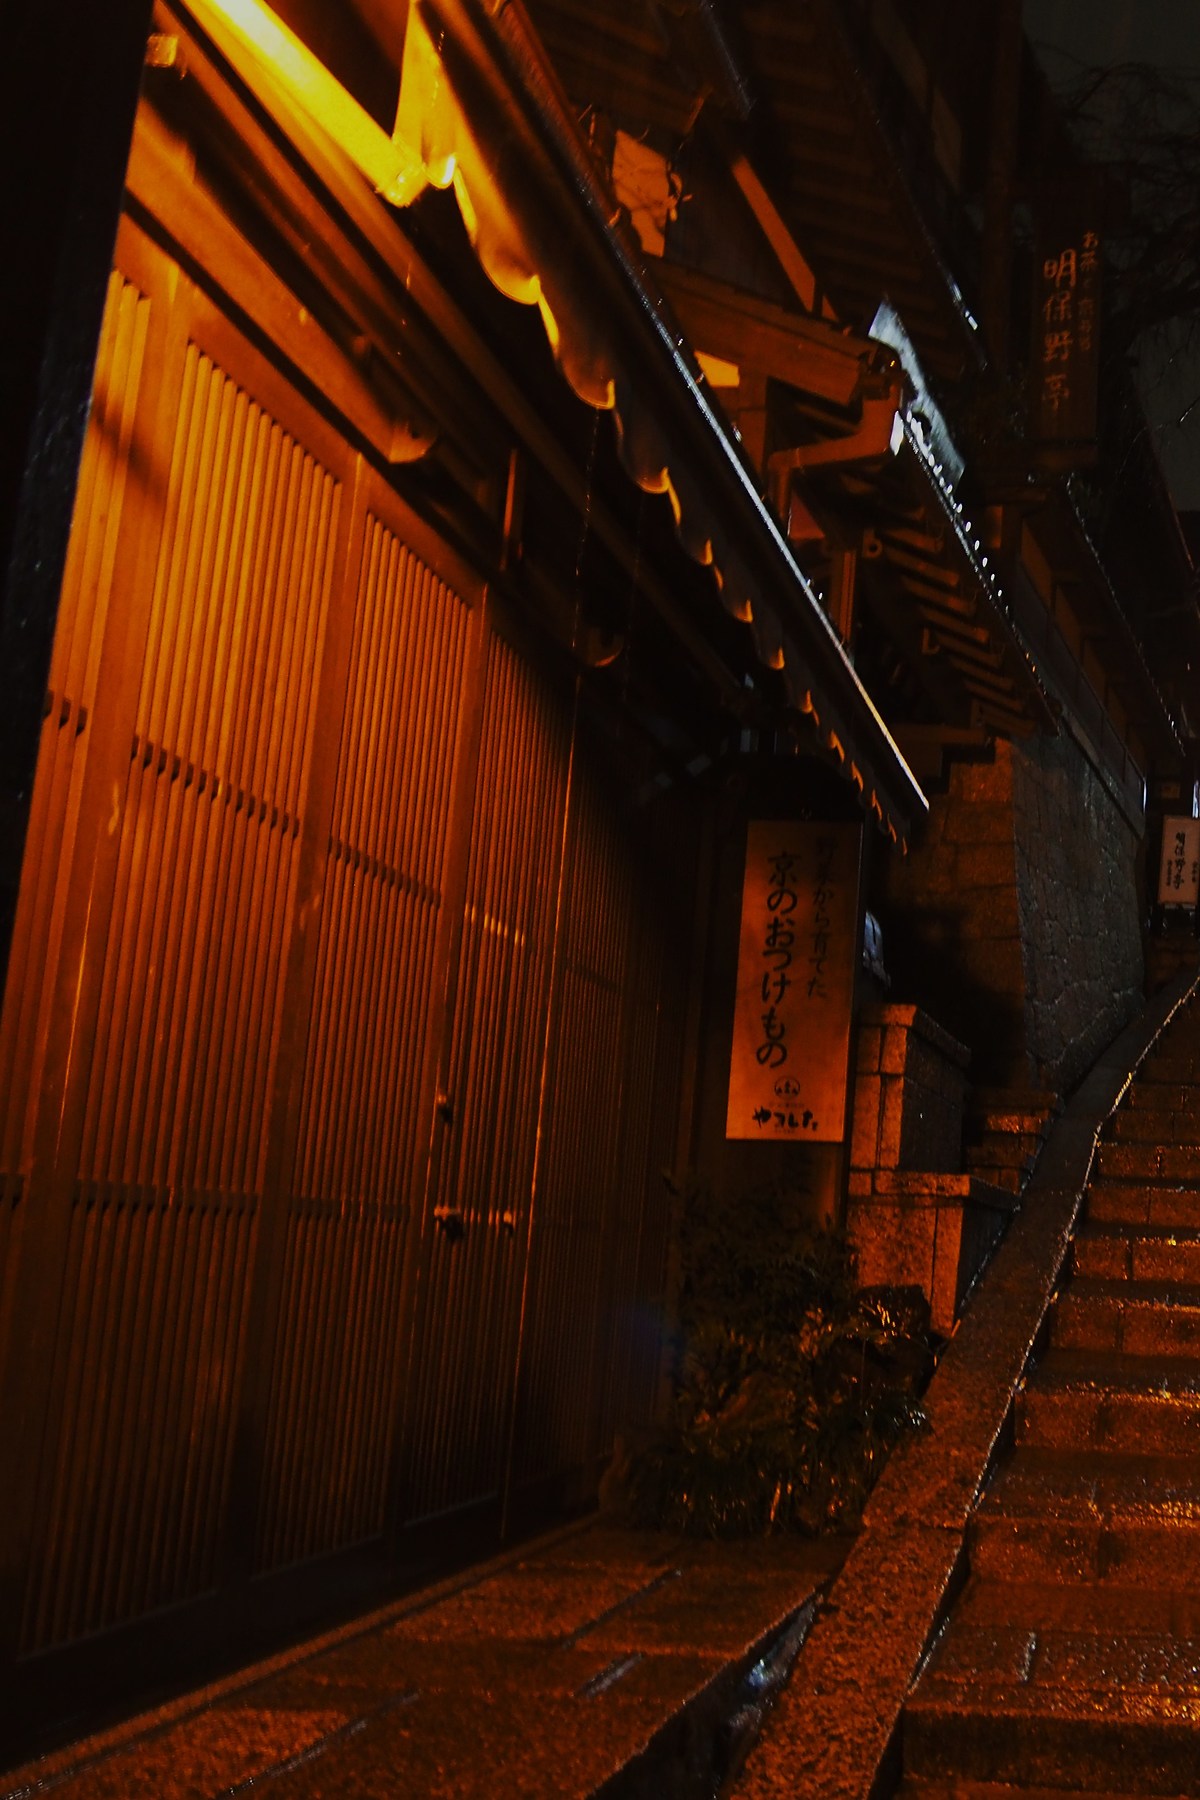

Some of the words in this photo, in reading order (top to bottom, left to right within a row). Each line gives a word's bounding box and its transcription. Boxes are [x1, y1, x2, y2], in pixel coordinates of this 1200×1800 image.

[1042, 247, 1078, 411] 明保野亭
[756, 853, 801, 1068] 京のおつけもの
